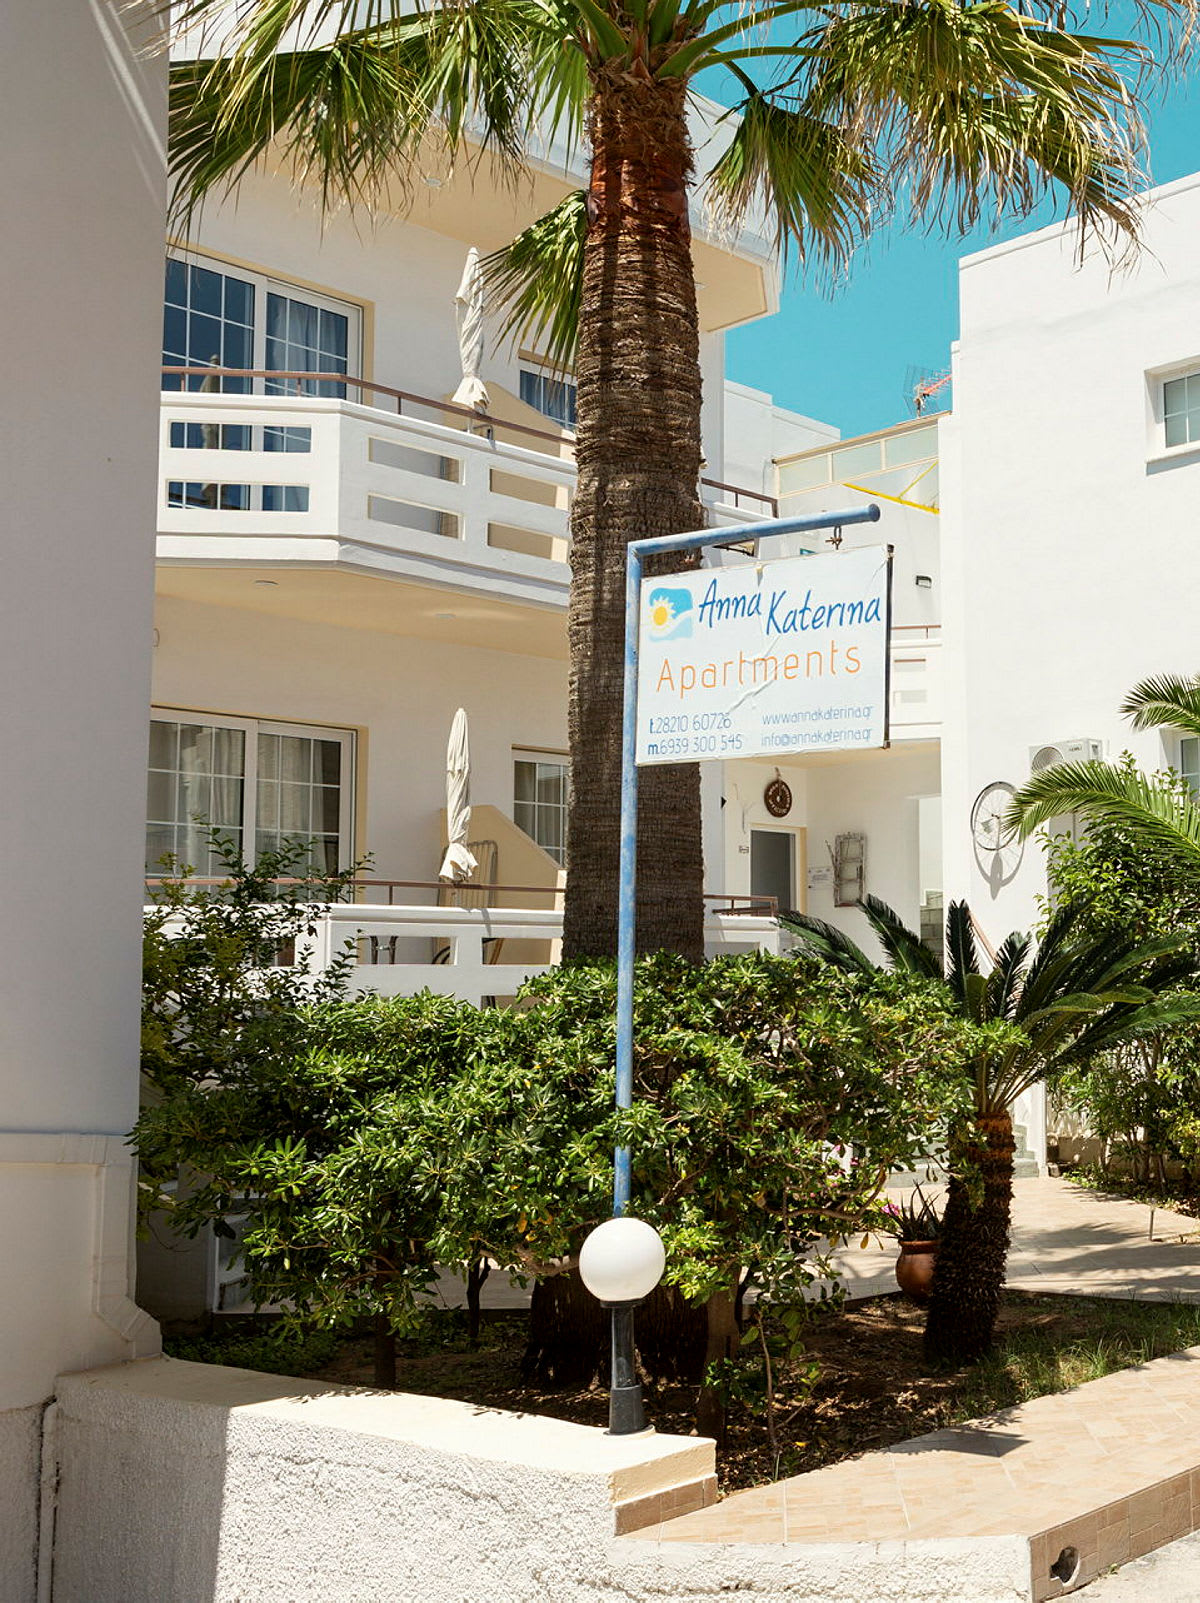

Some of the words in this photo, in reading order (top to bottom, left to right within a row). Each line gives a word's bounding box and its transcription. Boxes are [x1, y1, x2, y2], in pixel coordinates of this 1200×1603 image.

[698, 578, 762, 628] Anna
[766, 590, 881, 636] Katerina
[656, 639, 861, 699] Apartments
[692, 712, 732, 731] 60726
[693, 735, 717, 753] 300
[720, 733, 743, 751] 545
